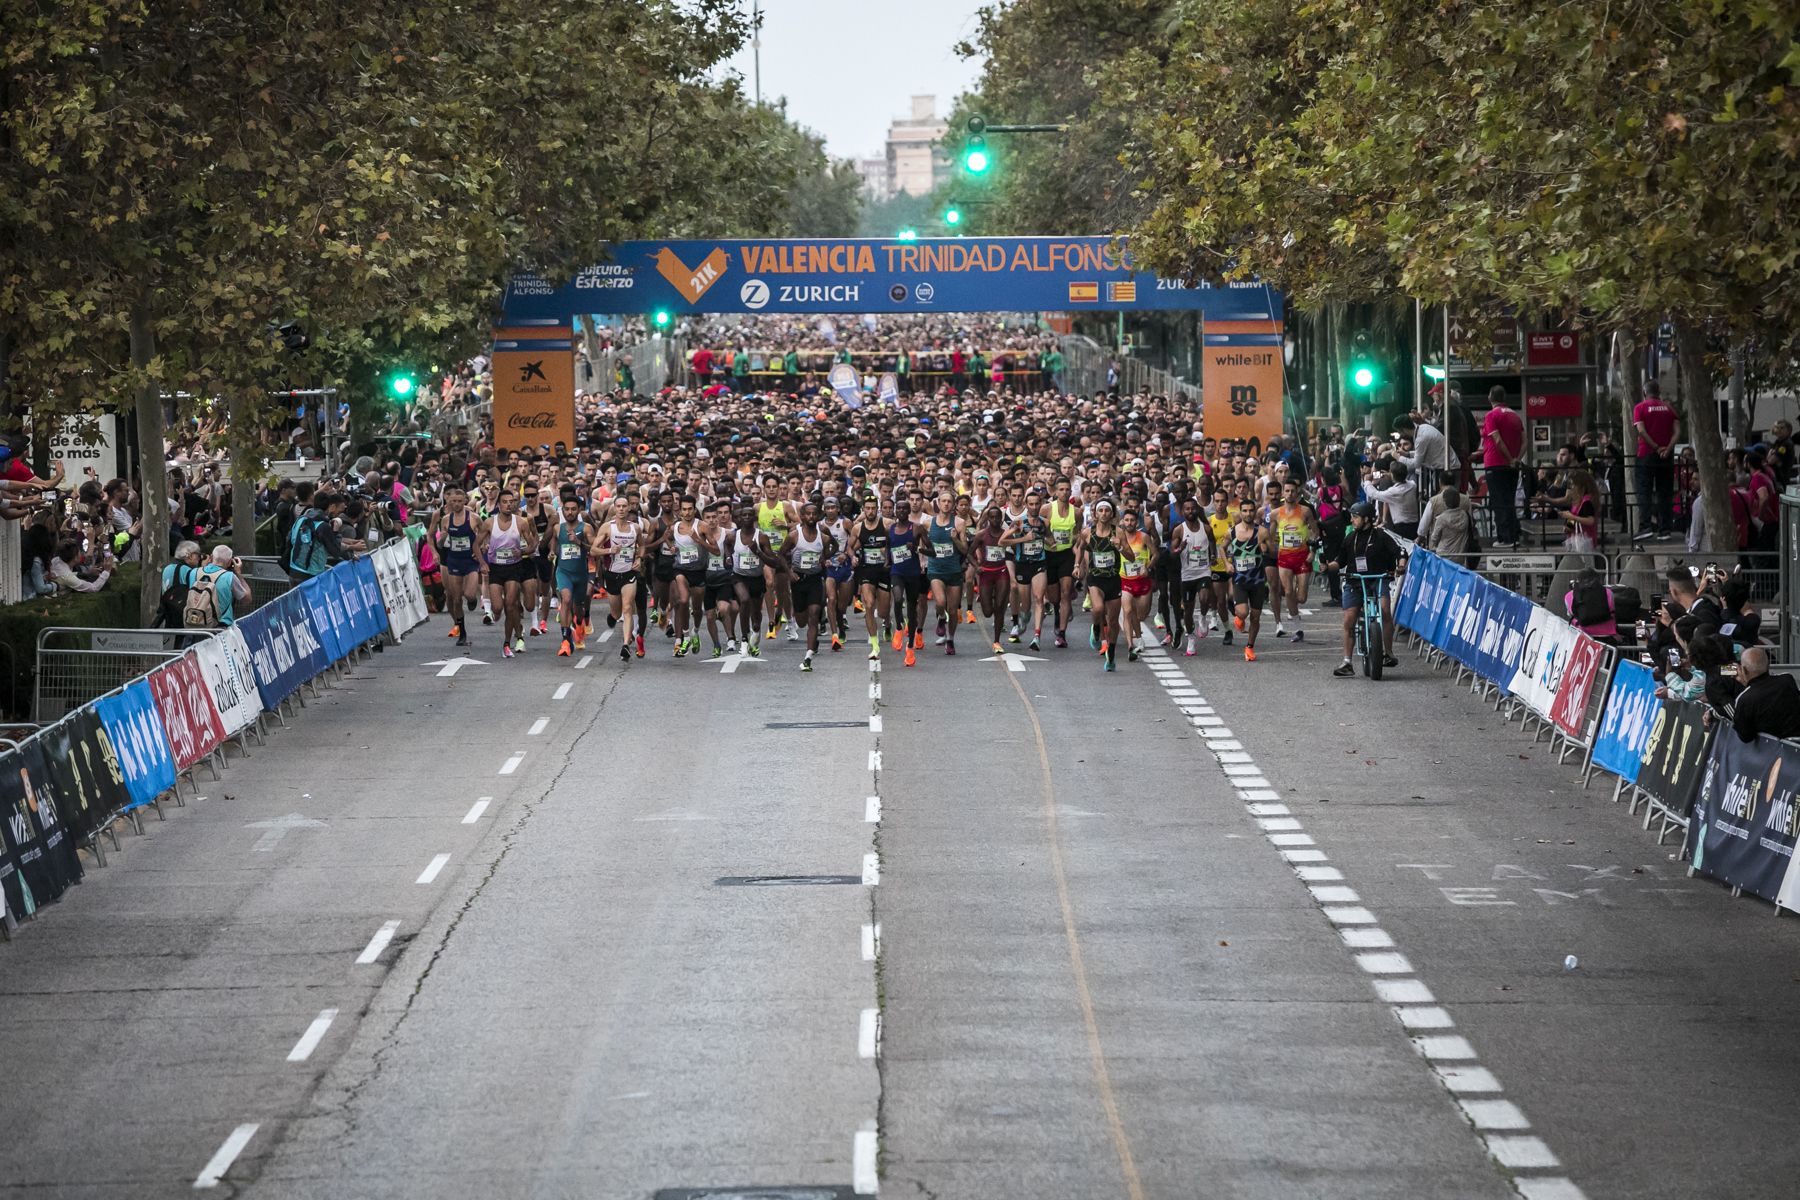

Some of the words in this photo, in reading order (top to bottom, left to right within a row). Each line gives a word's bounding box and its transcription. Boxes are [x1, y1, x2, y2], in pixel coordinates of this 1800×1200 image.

[741, 246, 875, 273] VALENCIA
[882, 244, 1005, 272] TRINIDAD
[513, 280, 552, 288] TRINIDA
[575, 276, 634, 289] Esfuerzo
[690, 262, 718, 294] 21K
[1156, 279, 1211, 290] ZURH
[779, 285, 859, 302] ZURICH
[1216, 353, 1273, 366] whileBIT
[512, 385, 553, 393] CaixaBank
[508, 412, 558, 429] Coca-Cola
[67, 446, 101, 459] más
